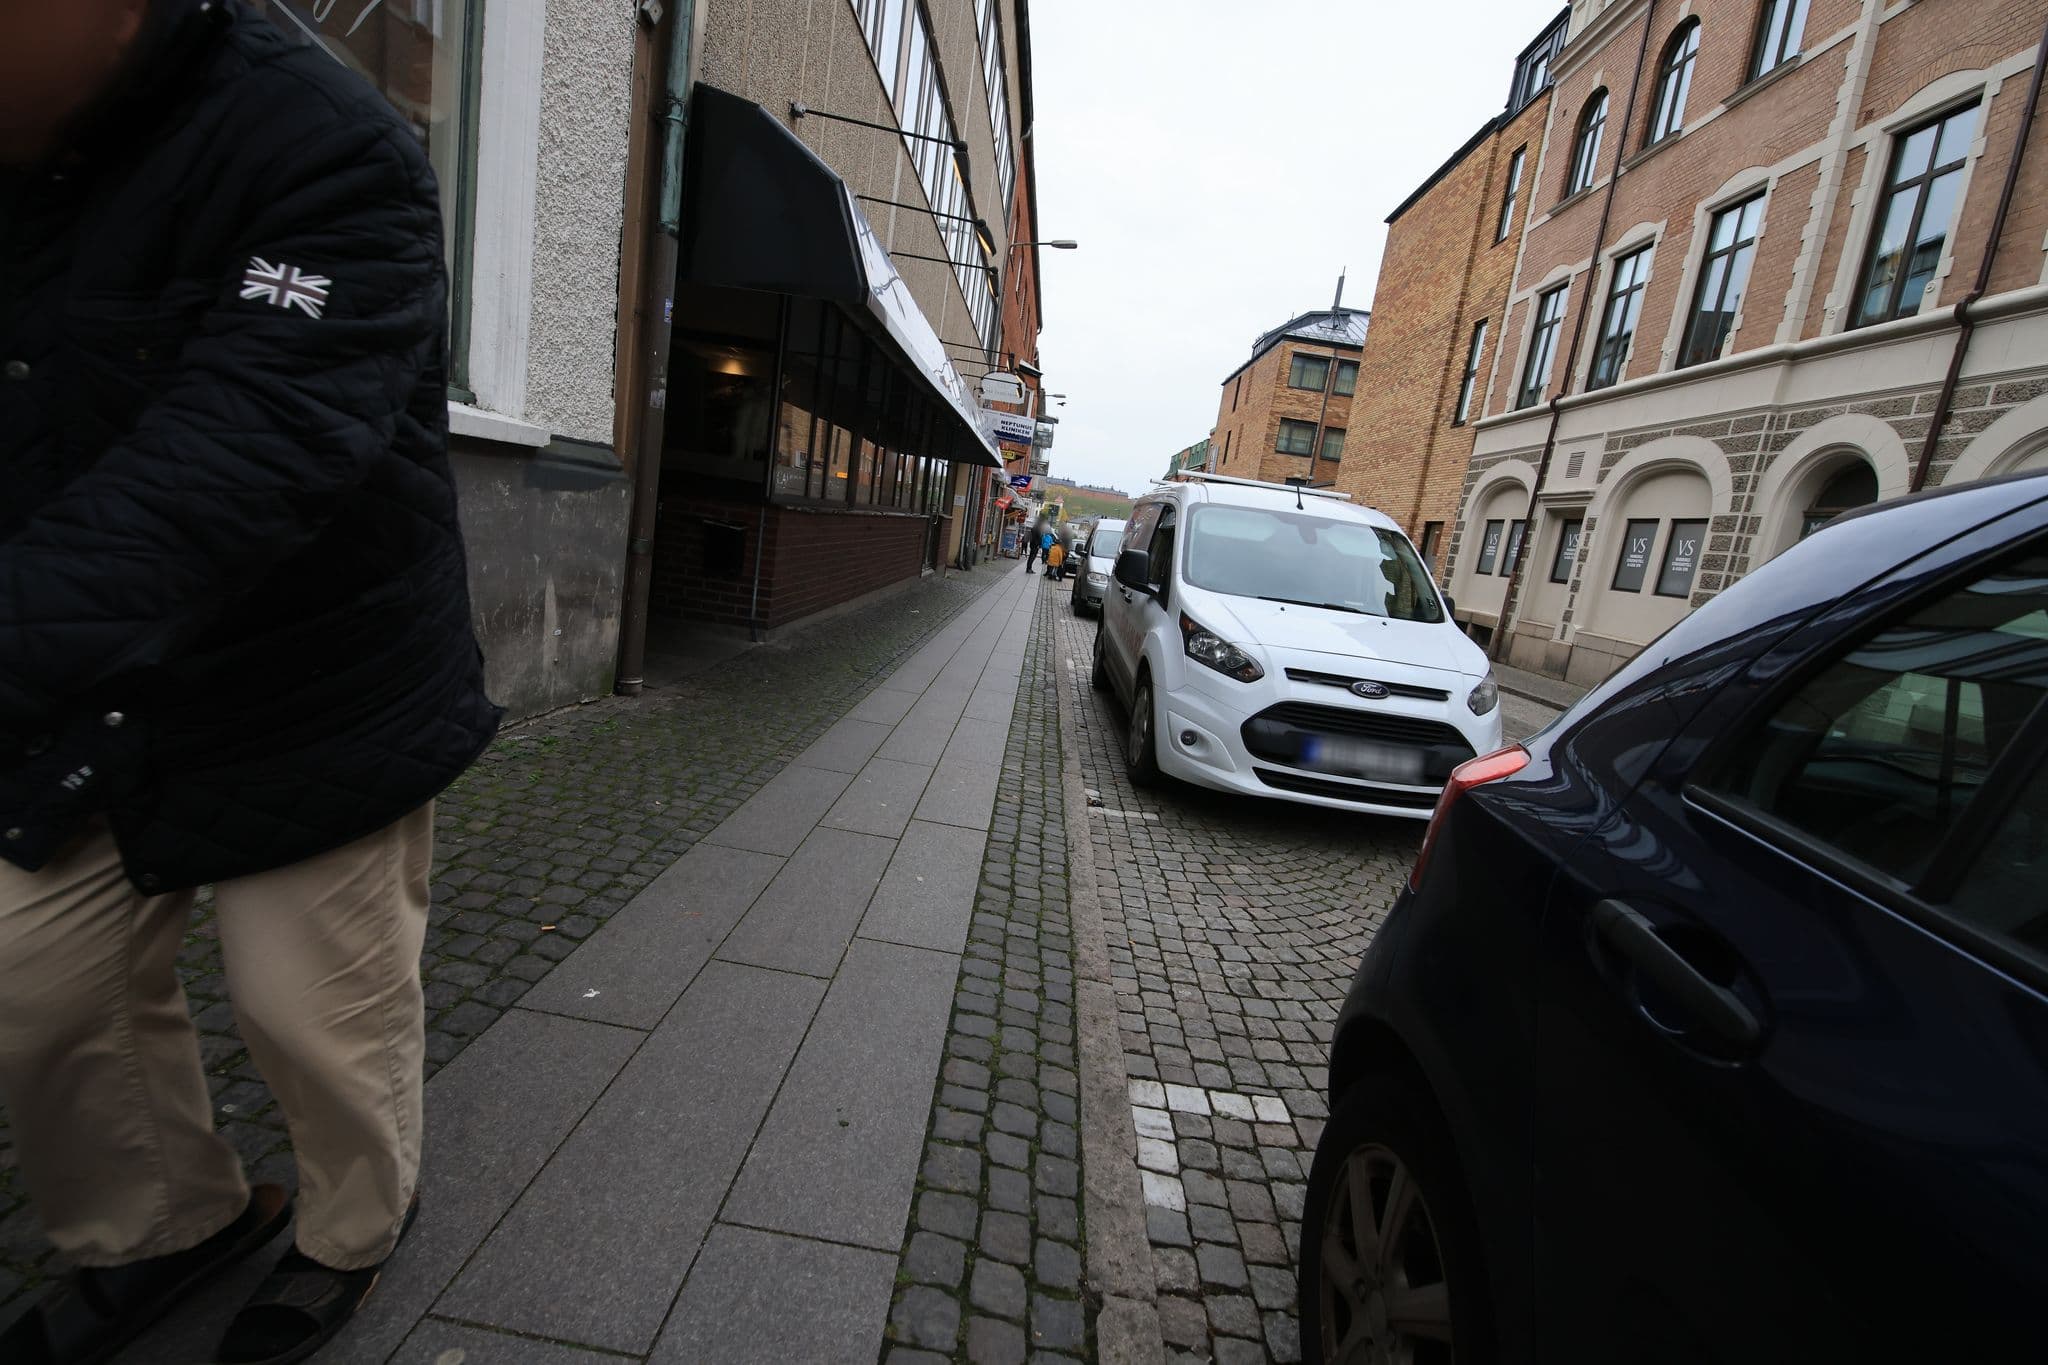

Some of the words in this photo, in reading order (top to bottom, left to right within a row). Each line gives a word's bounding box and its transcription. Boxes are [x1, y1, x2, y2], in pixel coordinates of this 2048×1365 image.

[1001, 420, 1033, 431] NEPTUNUS
[1001, 425, 1030, 435] KLINIKEN
[1632, 537, 1648, 554] VS
[1679, 539, 1695, 556] VS
[1360, 683, 1382, 694] Ford
